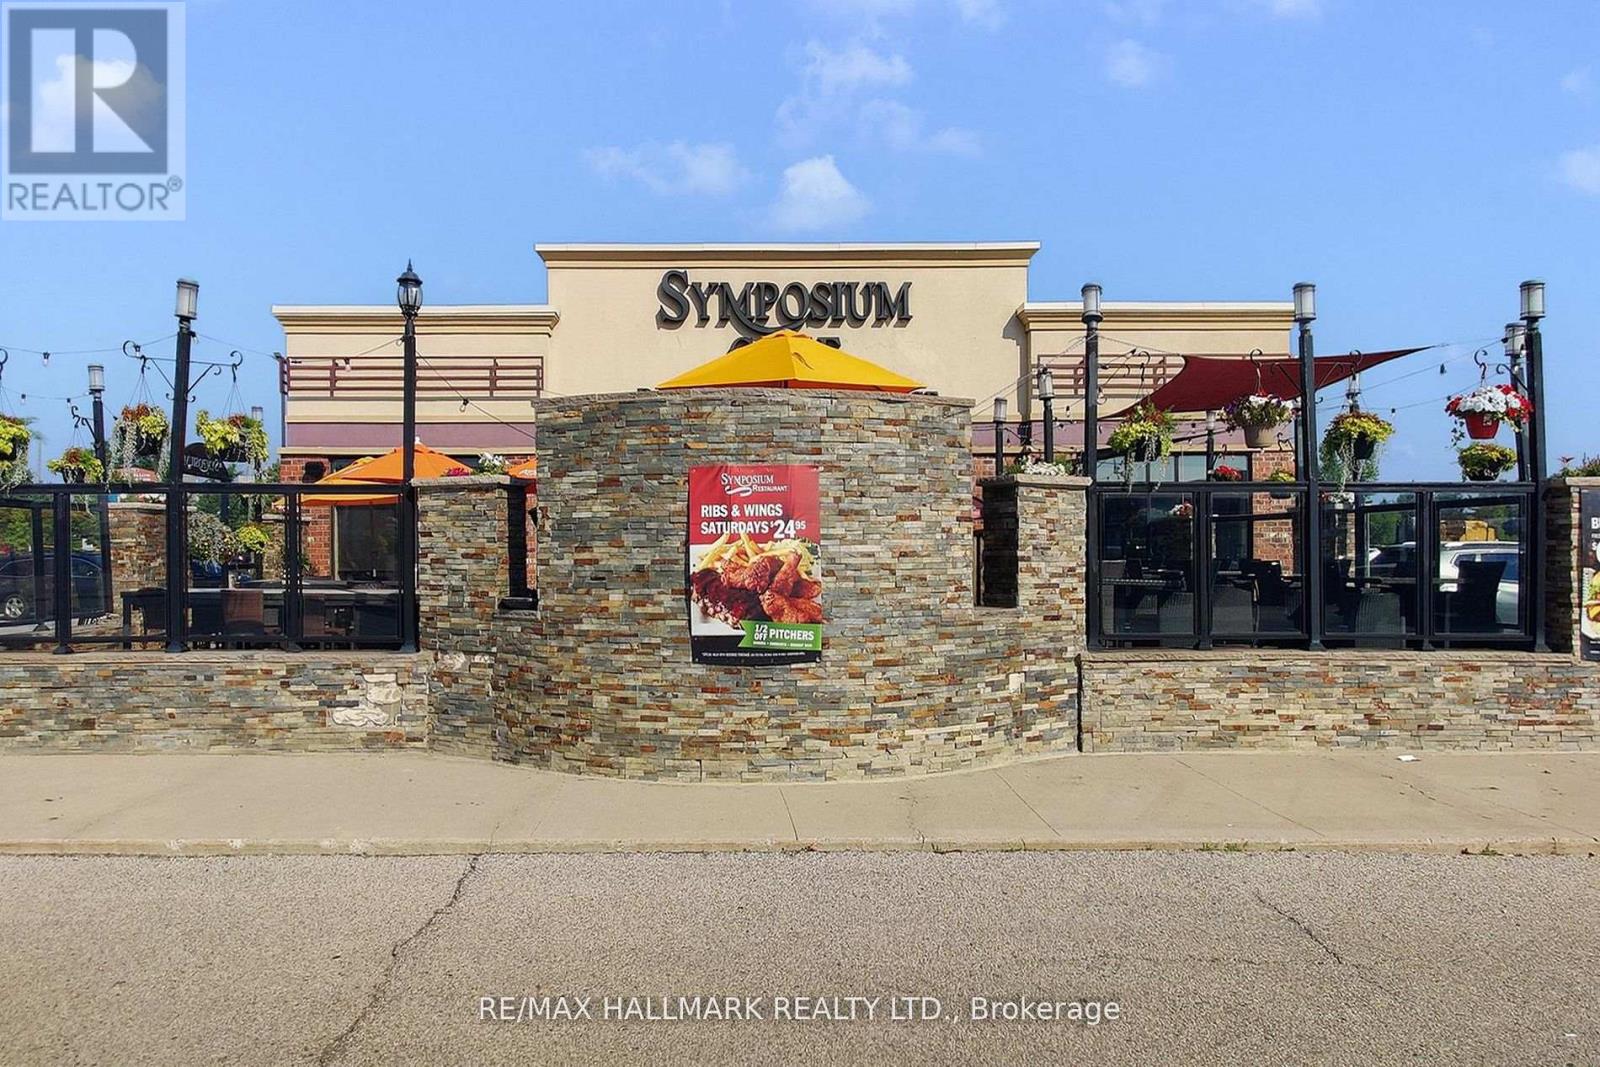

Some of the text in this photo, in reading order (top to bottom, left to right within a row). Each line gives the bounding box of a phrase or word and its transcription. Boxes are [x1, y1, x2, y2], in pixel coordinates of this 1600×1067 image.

[655, 269, 913, 334] SYMPOSIUM
[701, 503, 783, 517] RIBS & WINGS
[701, 521, 769, 535] SATURDAYS
[754, 632, 767, 641] OFF
[755, 624, 815, 640] 1/2 PITCHERS
